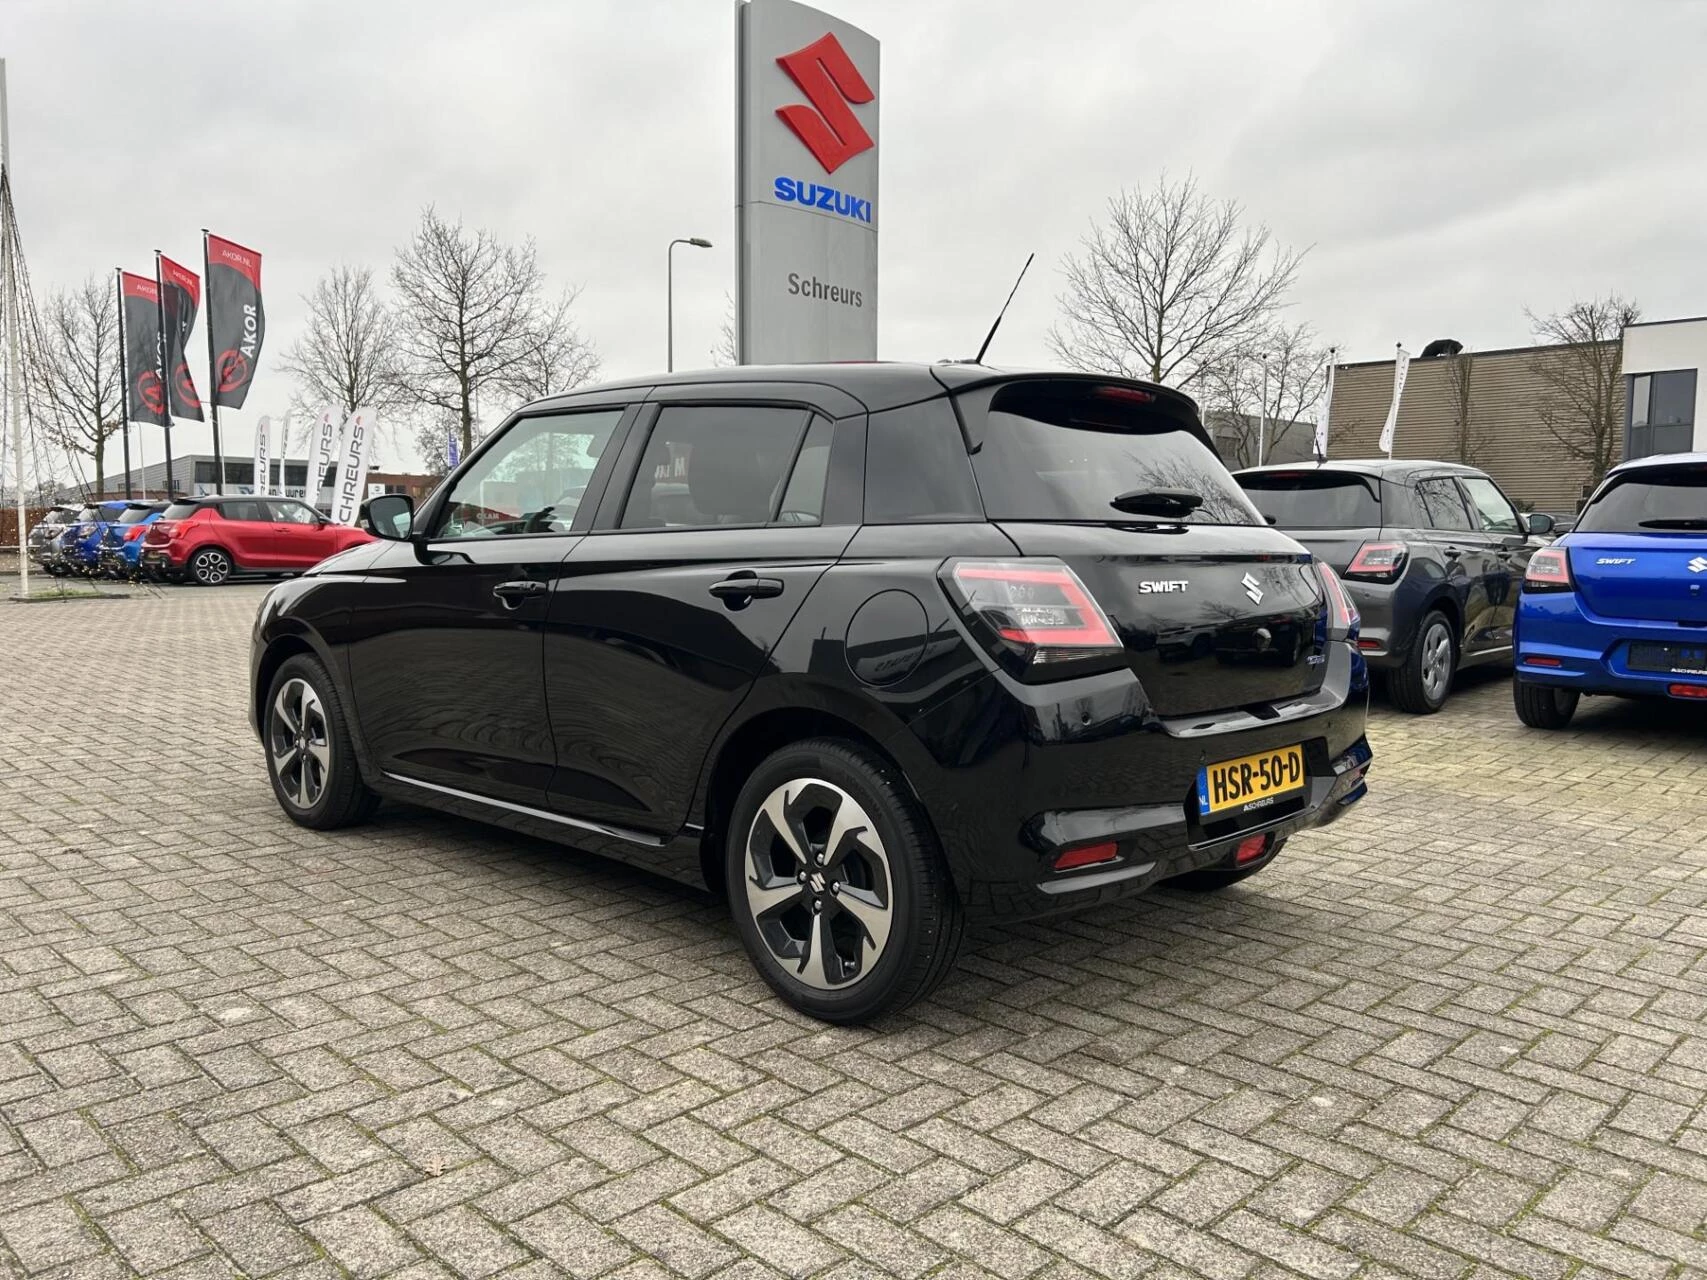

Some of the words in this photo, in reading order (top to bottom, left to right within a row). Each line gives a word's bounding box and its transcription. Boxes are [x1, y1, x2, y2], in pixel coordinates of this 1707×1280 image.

[774, 176, 872, 224] SUZUKI
[222, 249, 253, 267] AKOR.NL
[788, 272, 863, 308] Schreurs
[239, 304, 257, 358] AKOR
[338, 424, 364, 523] CHREURS
[1139, 580, 1189, 593] SWIFT
[1212, 751, 1300, 804] HSR-50-D
[1199, 795, 1208, 806] NL
